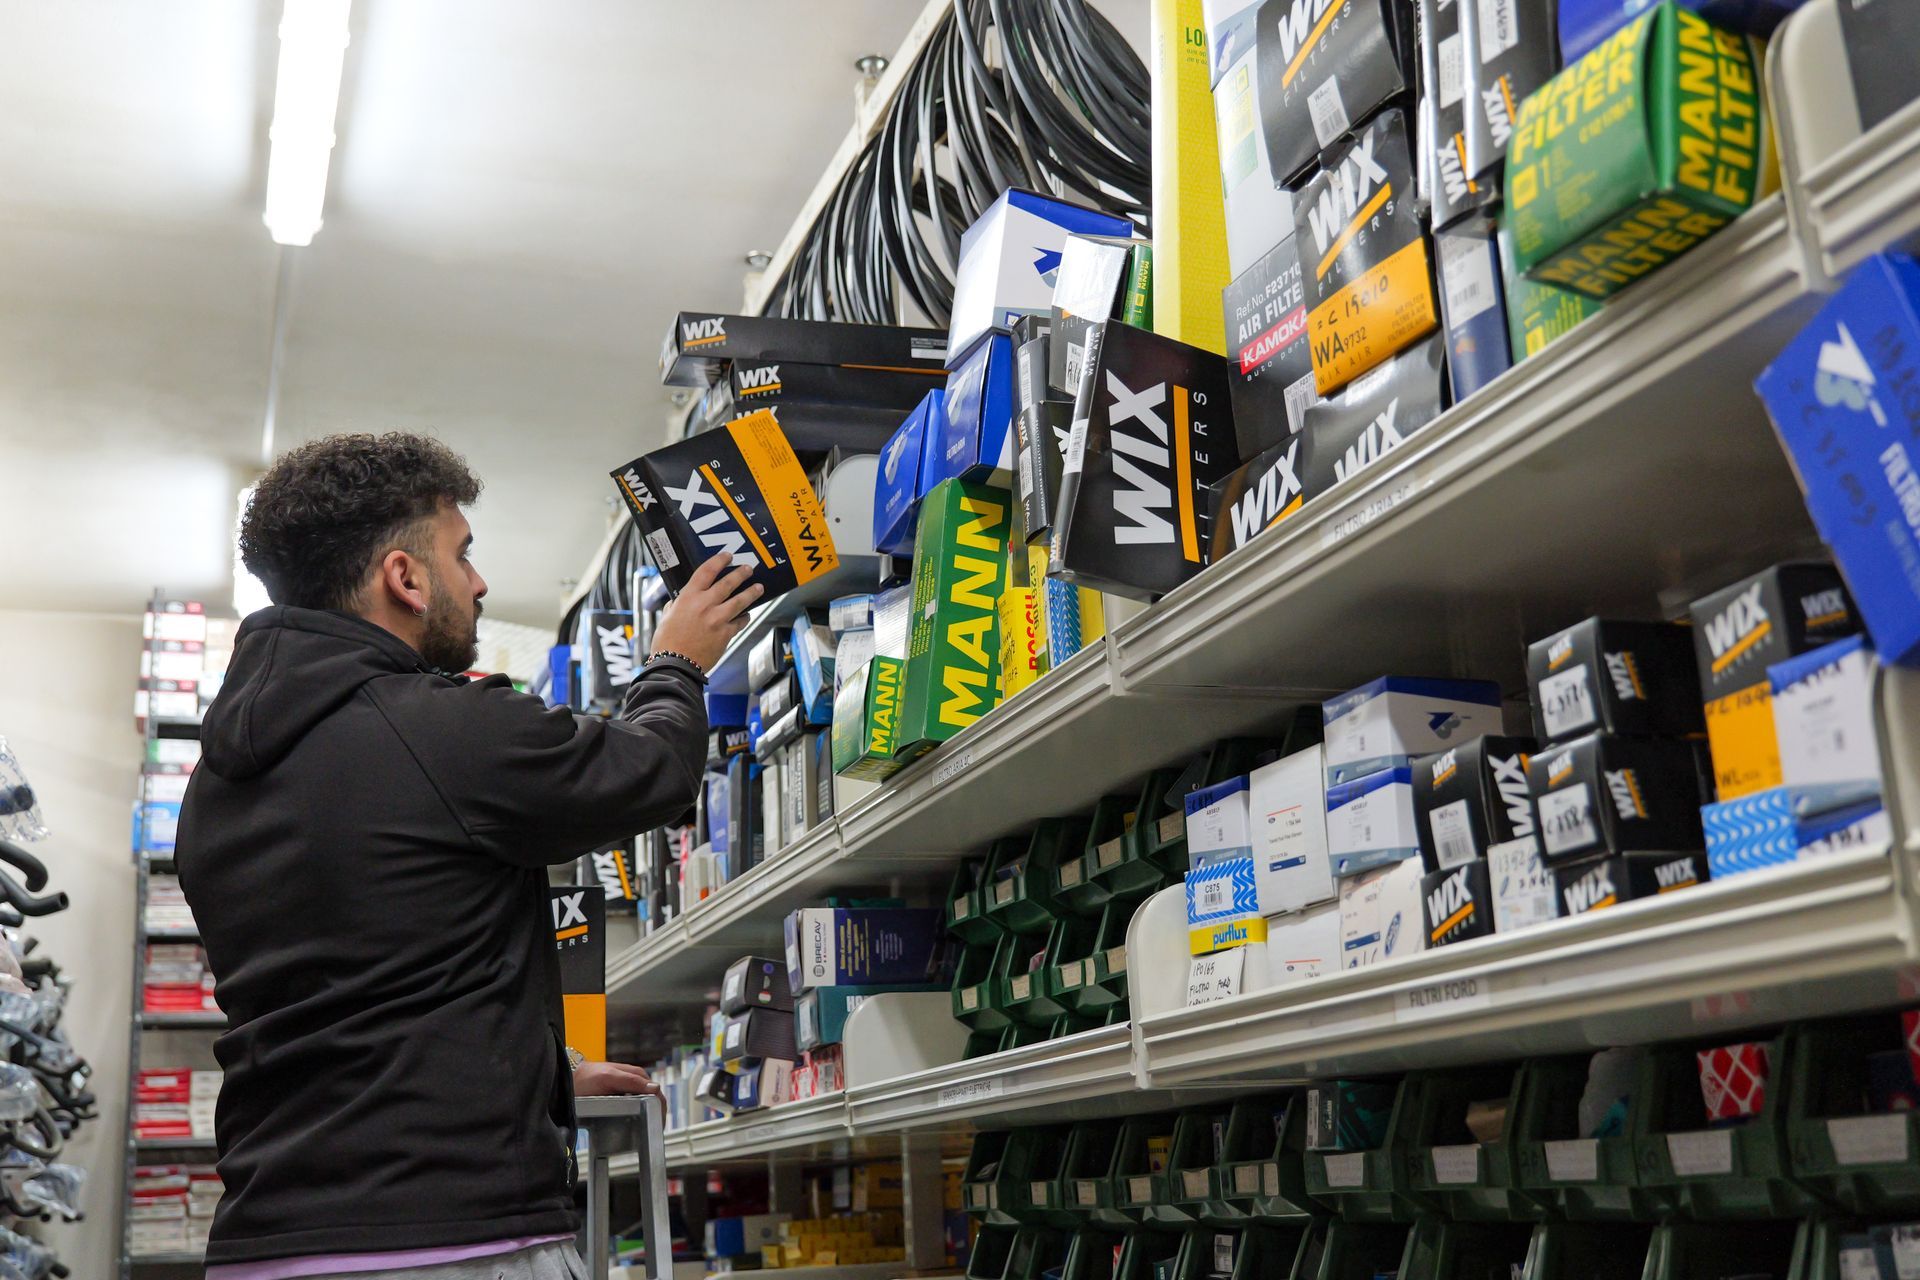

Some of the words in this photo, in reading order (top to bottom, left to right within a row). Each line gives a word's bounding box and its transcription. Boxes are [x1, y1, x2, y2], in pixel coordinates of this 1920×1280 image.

[1283, 2, 1352, 107] FILTERS
[1519, 18, 1644, 127] MANN
[1481, 79, 1512, 148] WIX
[1512, 51, 1636, 165] FILTER
[1677, 10, 1717, 192] MANN
[1712, 28, 1755, 204] FILTER
[1308, 126, 1388, 256] WIX
[1437, 136, 1467, 205] WIX
[1540, 200, 1691, 284] MANN
[1578, 213, 1724, 295] FILTER
[683, 317, 726, 341] WIX
[1238, 314, 1262, 344] AIR
[1265, 282, 1304, 324] FILTE
[739, 366, 781, 390] WIX
[1280, 338, 1309, 361] part
[1314, 326, 1368, 369] WA9732
[1019, 415, 1028, 444] WIX
[1106, 369, 1176, 545] WIX
[1333, 397, 1402, 483] WIX
[624, 467, 659, 511] WIX
[710, 459, 787, 566] FILTERS
[1230, 439, 1301, 550] WIX
[790, 491, 823, 572] WA9746
[1334, 512, 1373, 540] FILTRO
[939, 496, 1005, 728] MANN
[1704, 582, 1768, 658] WIX
[1801, 588, 1845, 618] WIX
[596, 625, 634, 686] WIX
[1604, 651, 1636, 699] WIX
[869, 662, 898, 753] MANN
[1487, 754, 1533, 837] WIX
[1604, 768, 1638, 820] WIX
[1427, 865, 1473, 927] WIX
[1564, 864, 1616, 915] WIX
[1655, 857, 1697, 884] WIX
[552, 890, 588, 930] IX
[815, 920, 823, 965] BRECAV
[1213, 924, 1248, 949] purflux
[1409, 989, 1443, 1008] FILTRI
[1444, 985, 1479, 1003] FORD
